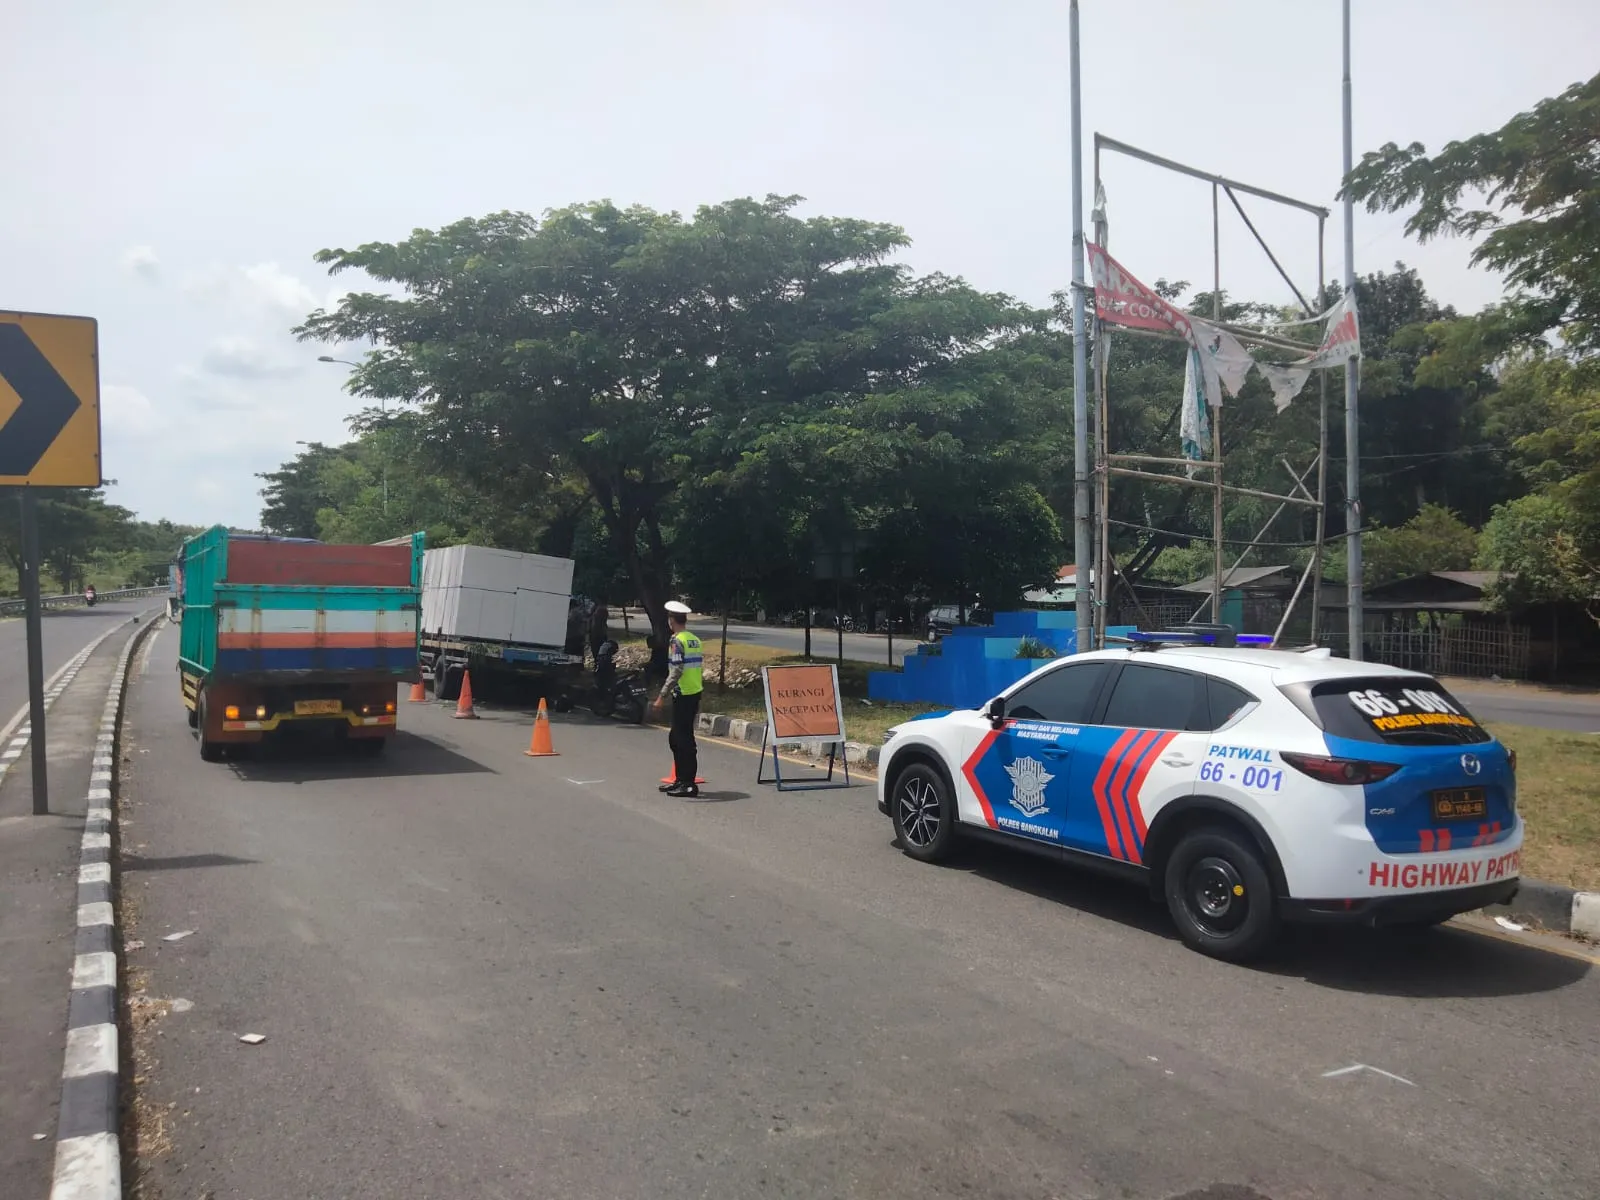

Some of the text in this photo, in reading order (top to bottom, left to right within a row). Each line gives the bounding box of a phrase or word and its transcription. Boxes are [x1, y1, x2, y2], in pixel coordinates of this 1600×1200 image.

[777, 687, 825, 698] KURANGI
[1347, 688, 1400, 716] 66
[1401, 688, 1460, 715] 001
[1208, 745, 1273, 762] PATWAL
[1200, 761, 1225, 782] 66
[1242, 766, 1283, 791] 001
[997, 816, 1059, 839] POLRES BANGKALAN
[1369, 861, 1482, 888] HIGHWAY
